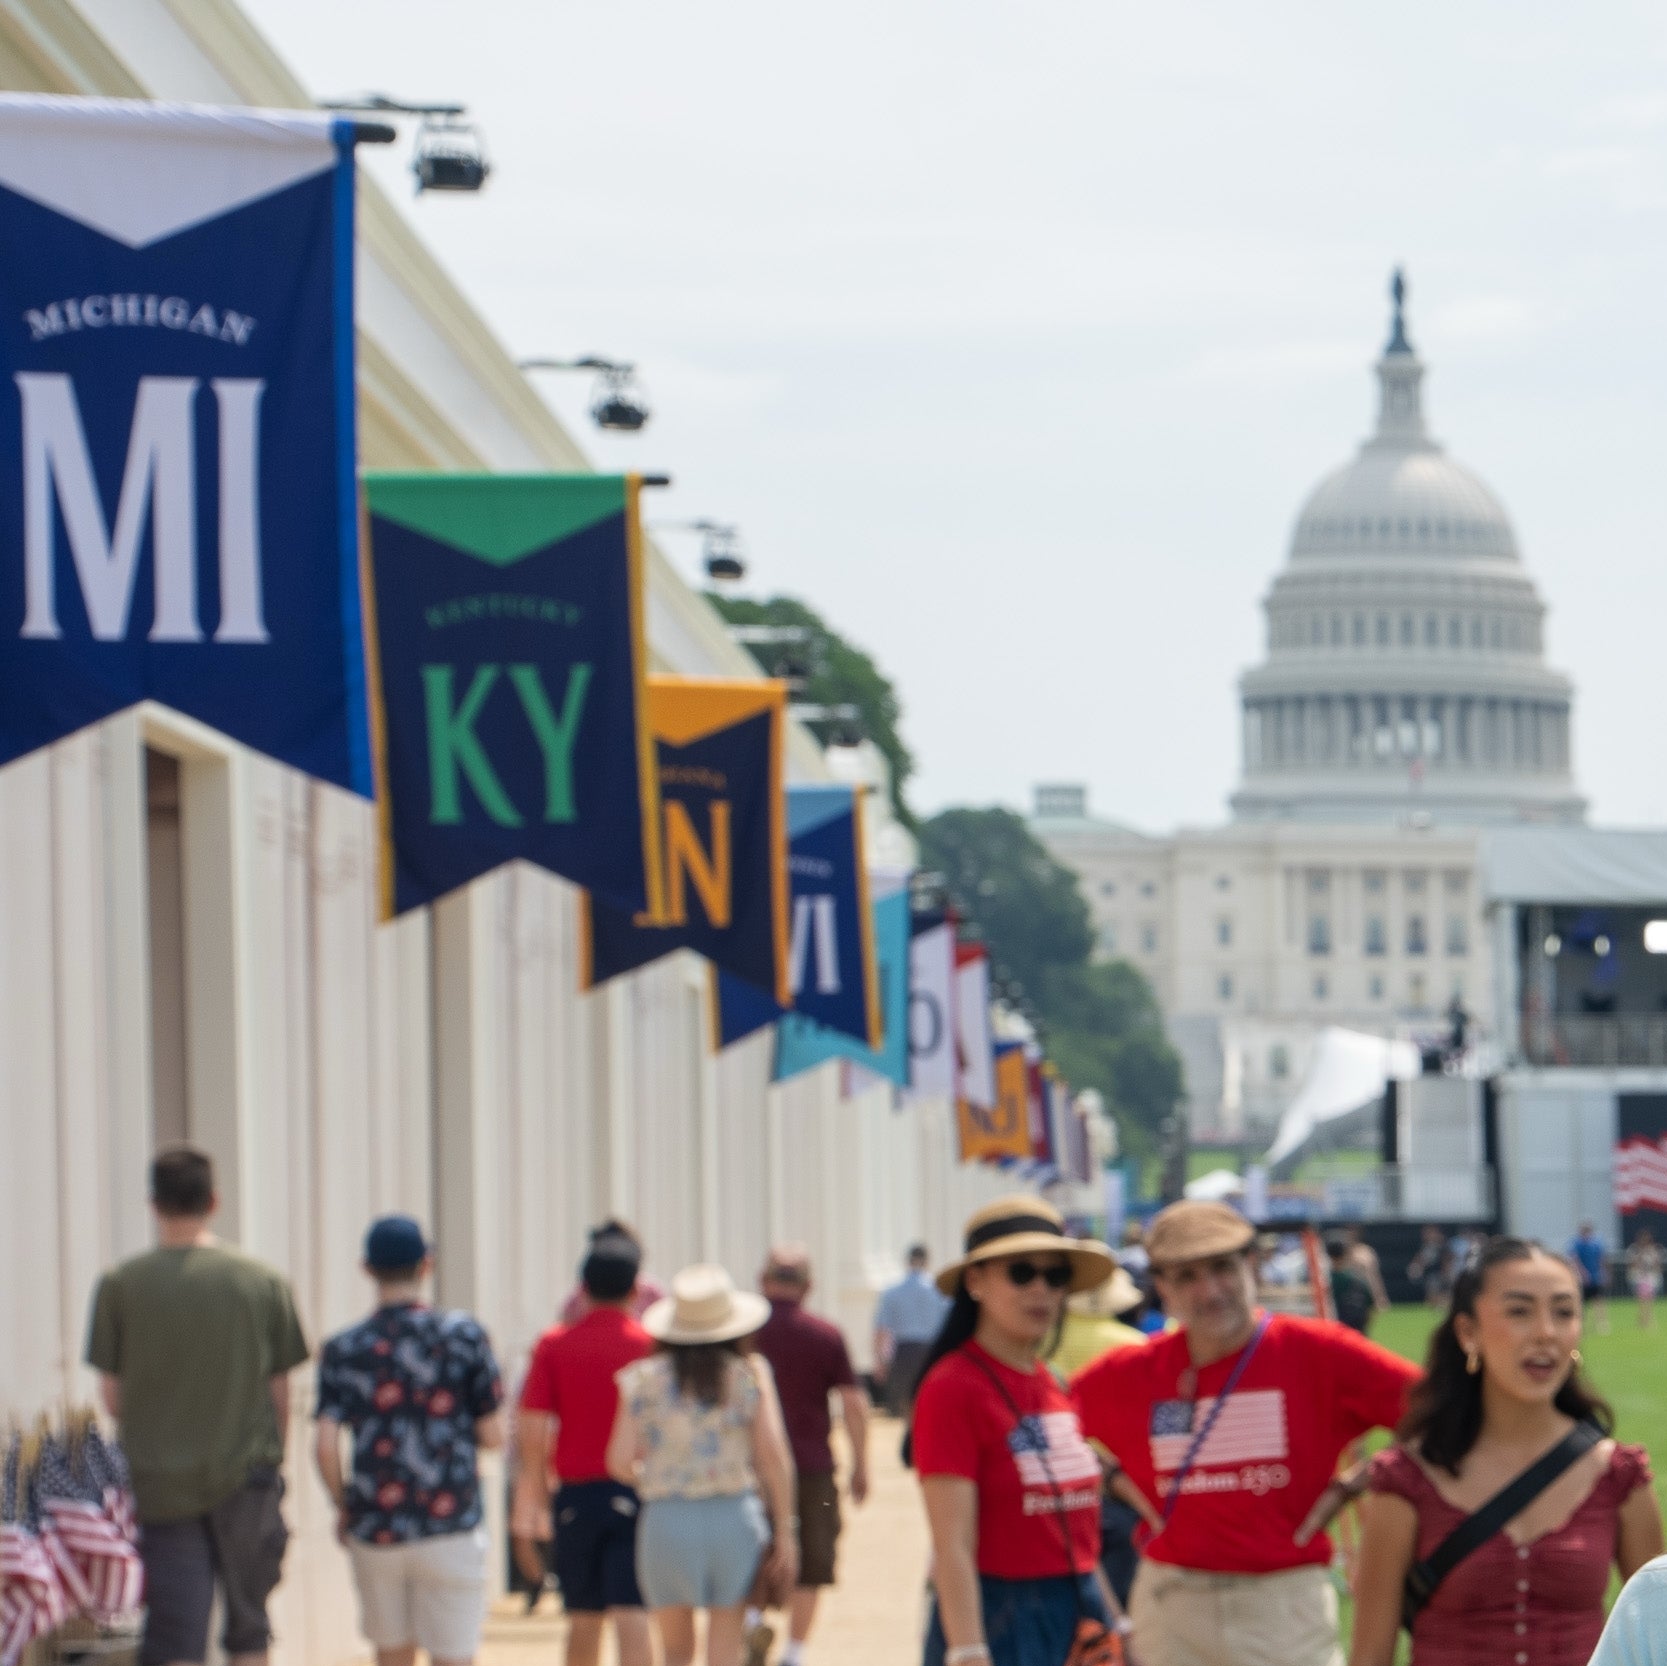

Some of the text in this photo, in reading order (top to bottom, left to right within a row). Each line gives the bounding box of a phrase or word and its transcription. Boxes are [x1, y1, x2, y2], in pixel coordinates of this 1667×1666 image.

[22, 293, 257, 345] MICHIGAN
[12, 371, 272, 645] MI
[422, 662, 594, 828] KY
[632, 798, 732, 928] N
[1240, 1463, 1291, 1496] 250
